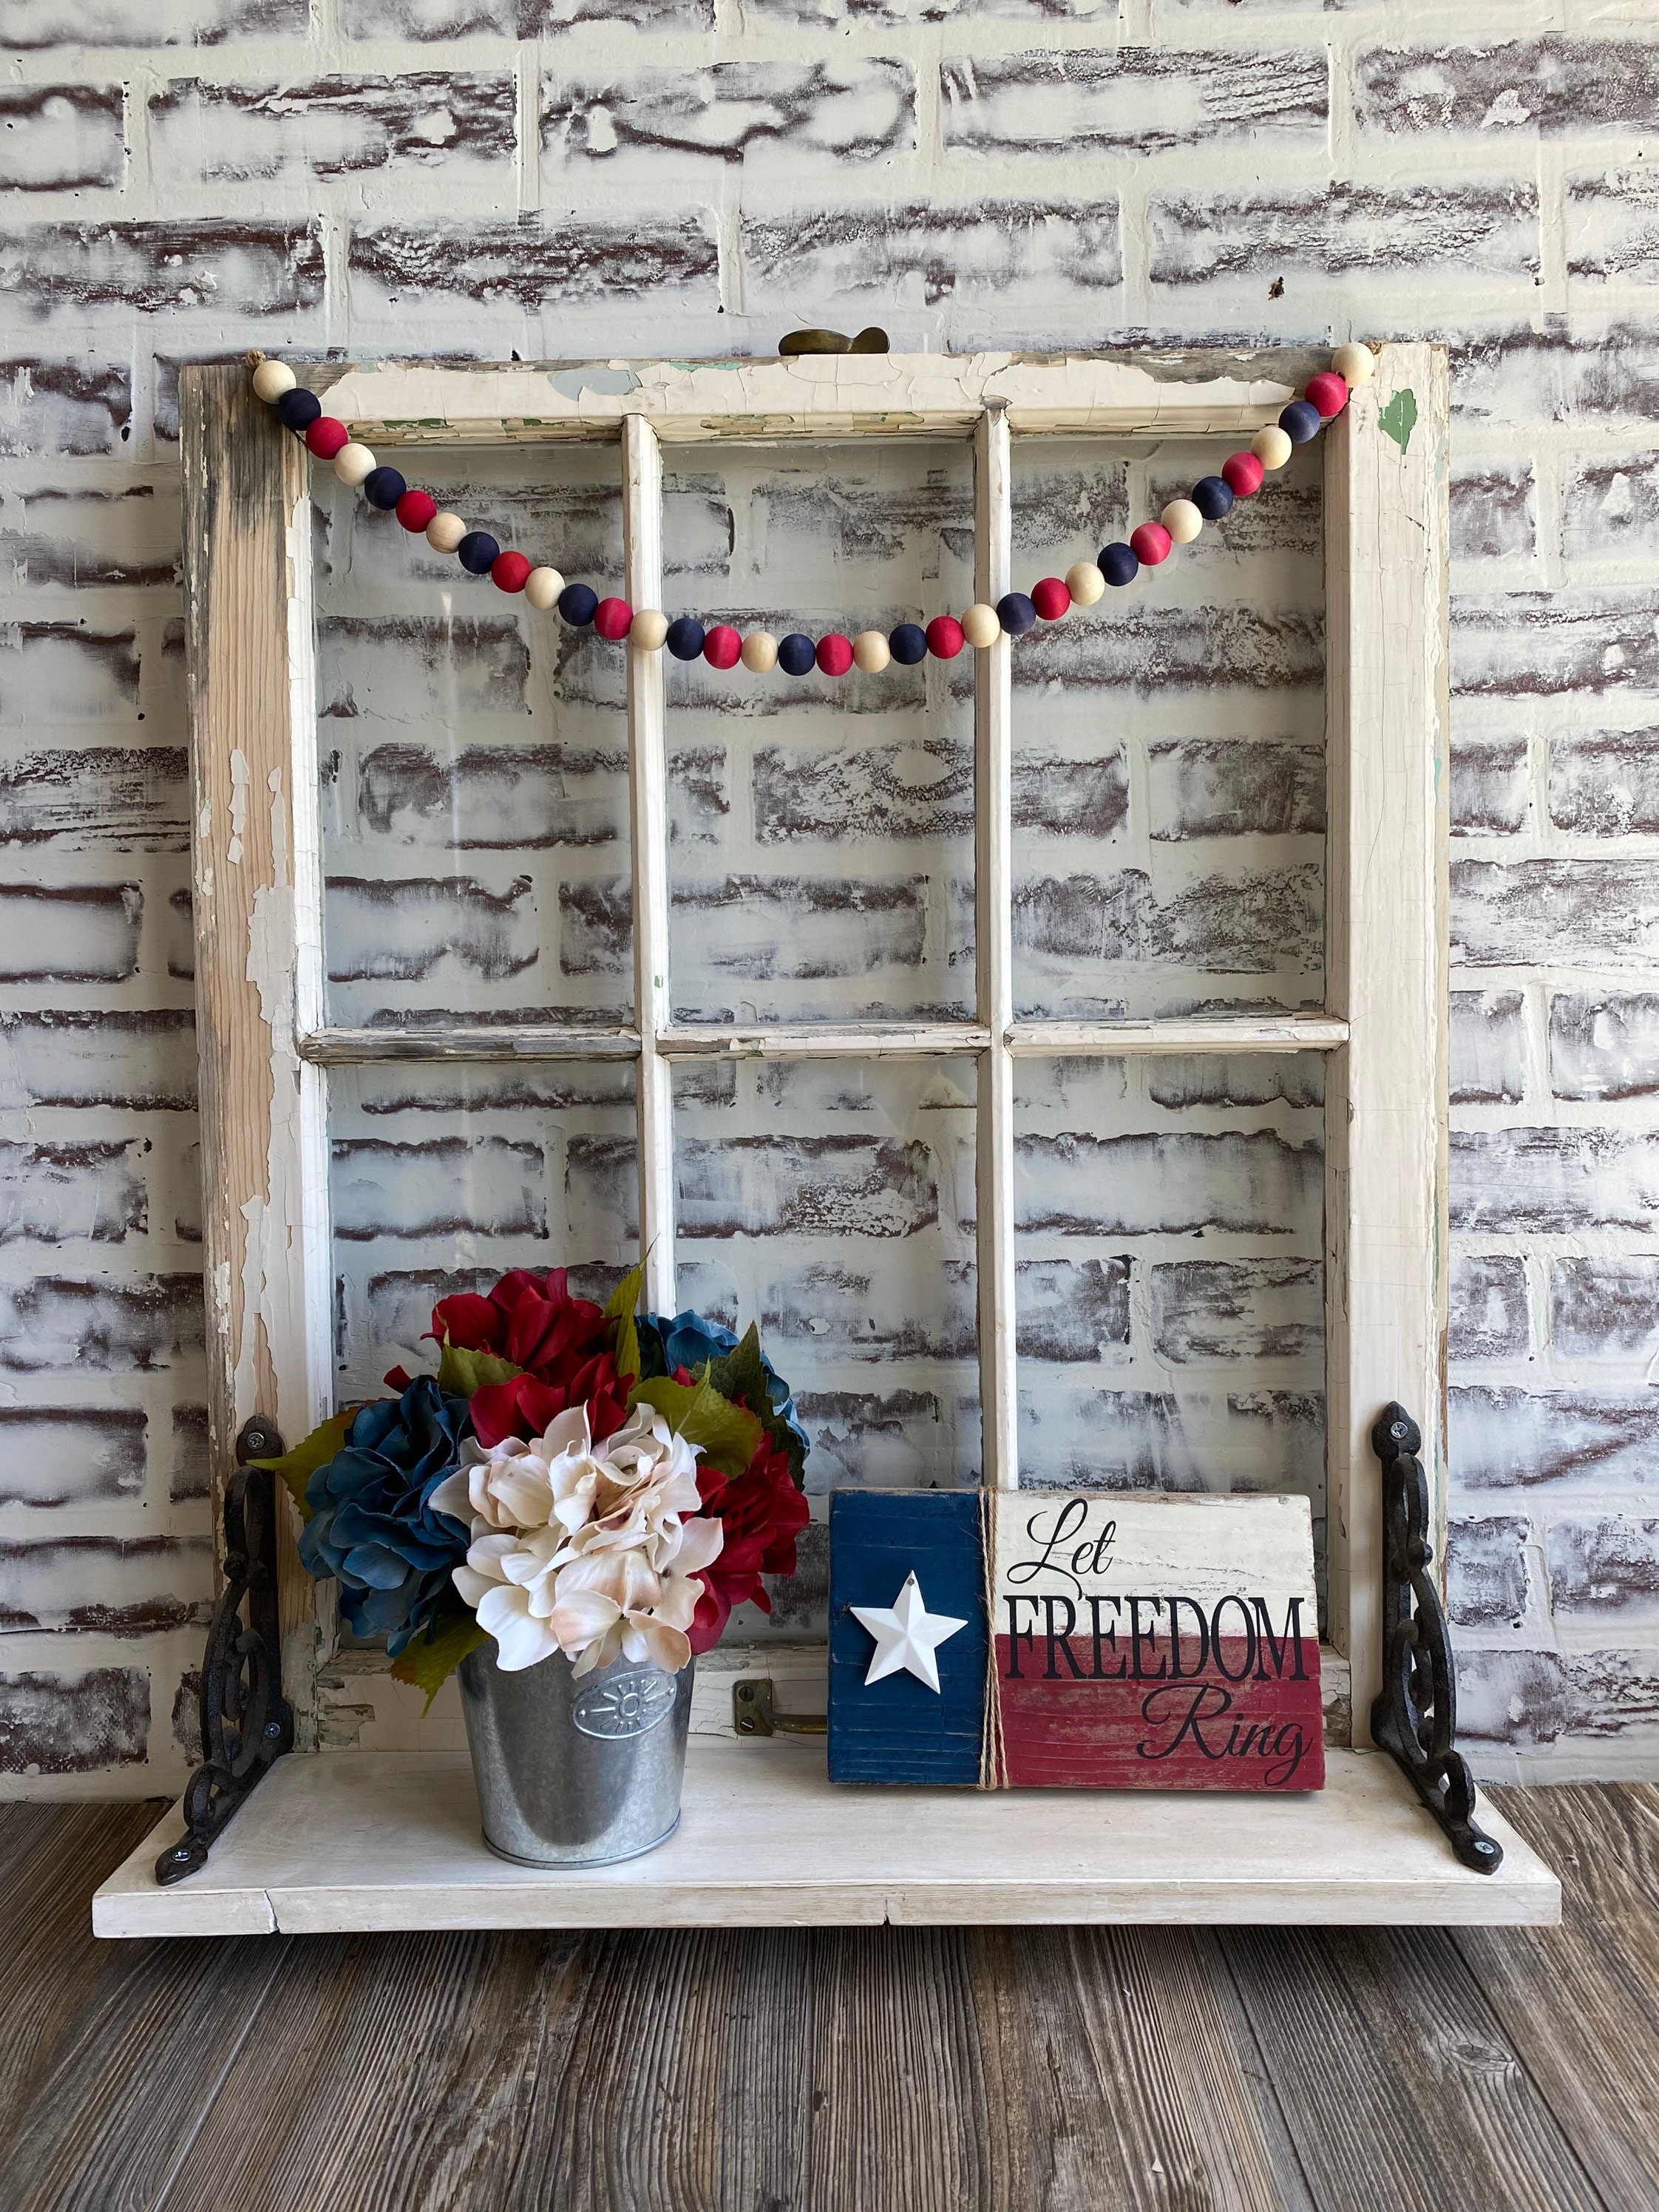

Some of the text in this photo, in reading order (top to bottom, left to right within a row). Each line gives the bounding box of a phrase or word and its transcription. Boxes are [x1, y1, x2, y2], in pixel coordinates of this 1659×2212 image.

[1006, 1498, 1116, 1601] Let
[1002, 1594, 1310, 1682] FREEDOM
[1136, 1683, 1313, 1786] Ring
